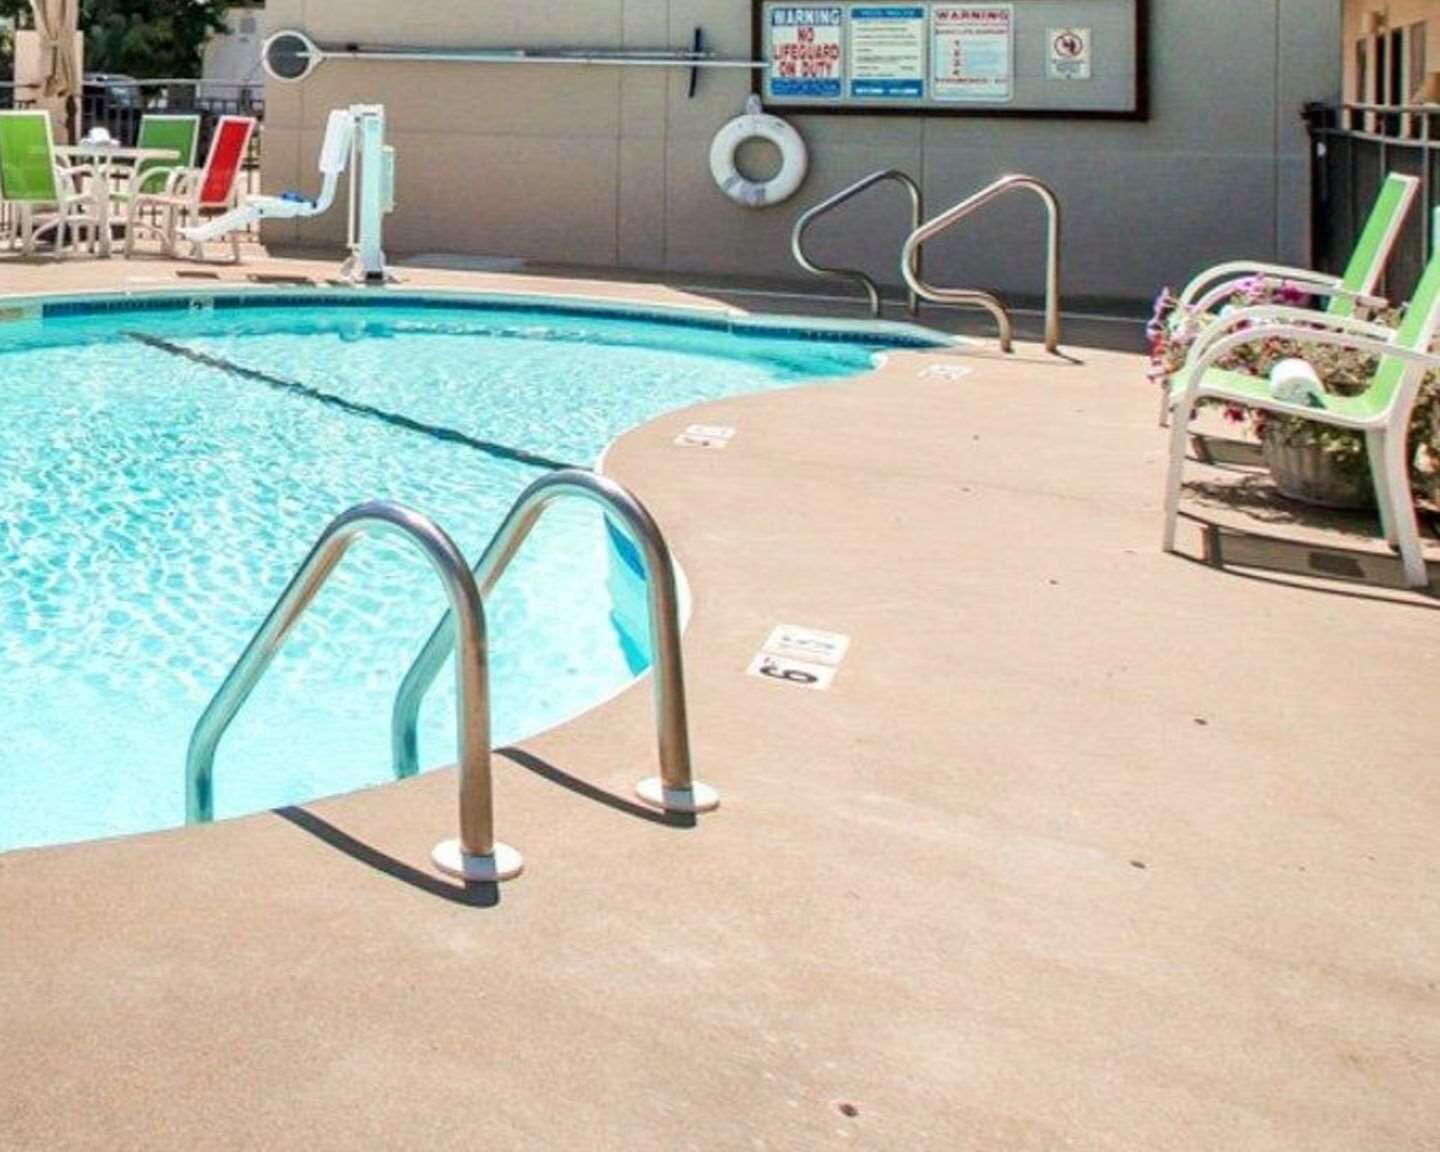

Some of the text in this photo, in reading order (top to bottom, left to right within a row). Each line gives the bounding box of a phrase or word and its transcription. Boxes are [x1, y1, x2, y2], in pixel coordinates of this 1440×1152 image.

[772, 9, 841, 25] WARNING
[935, 10, 1008, 21] WARNING
[797, 27, 814, 43] NO
[773, 43, 840, 61] LIFEGUARD
[779, 61, 833, 78] ON DUTY
